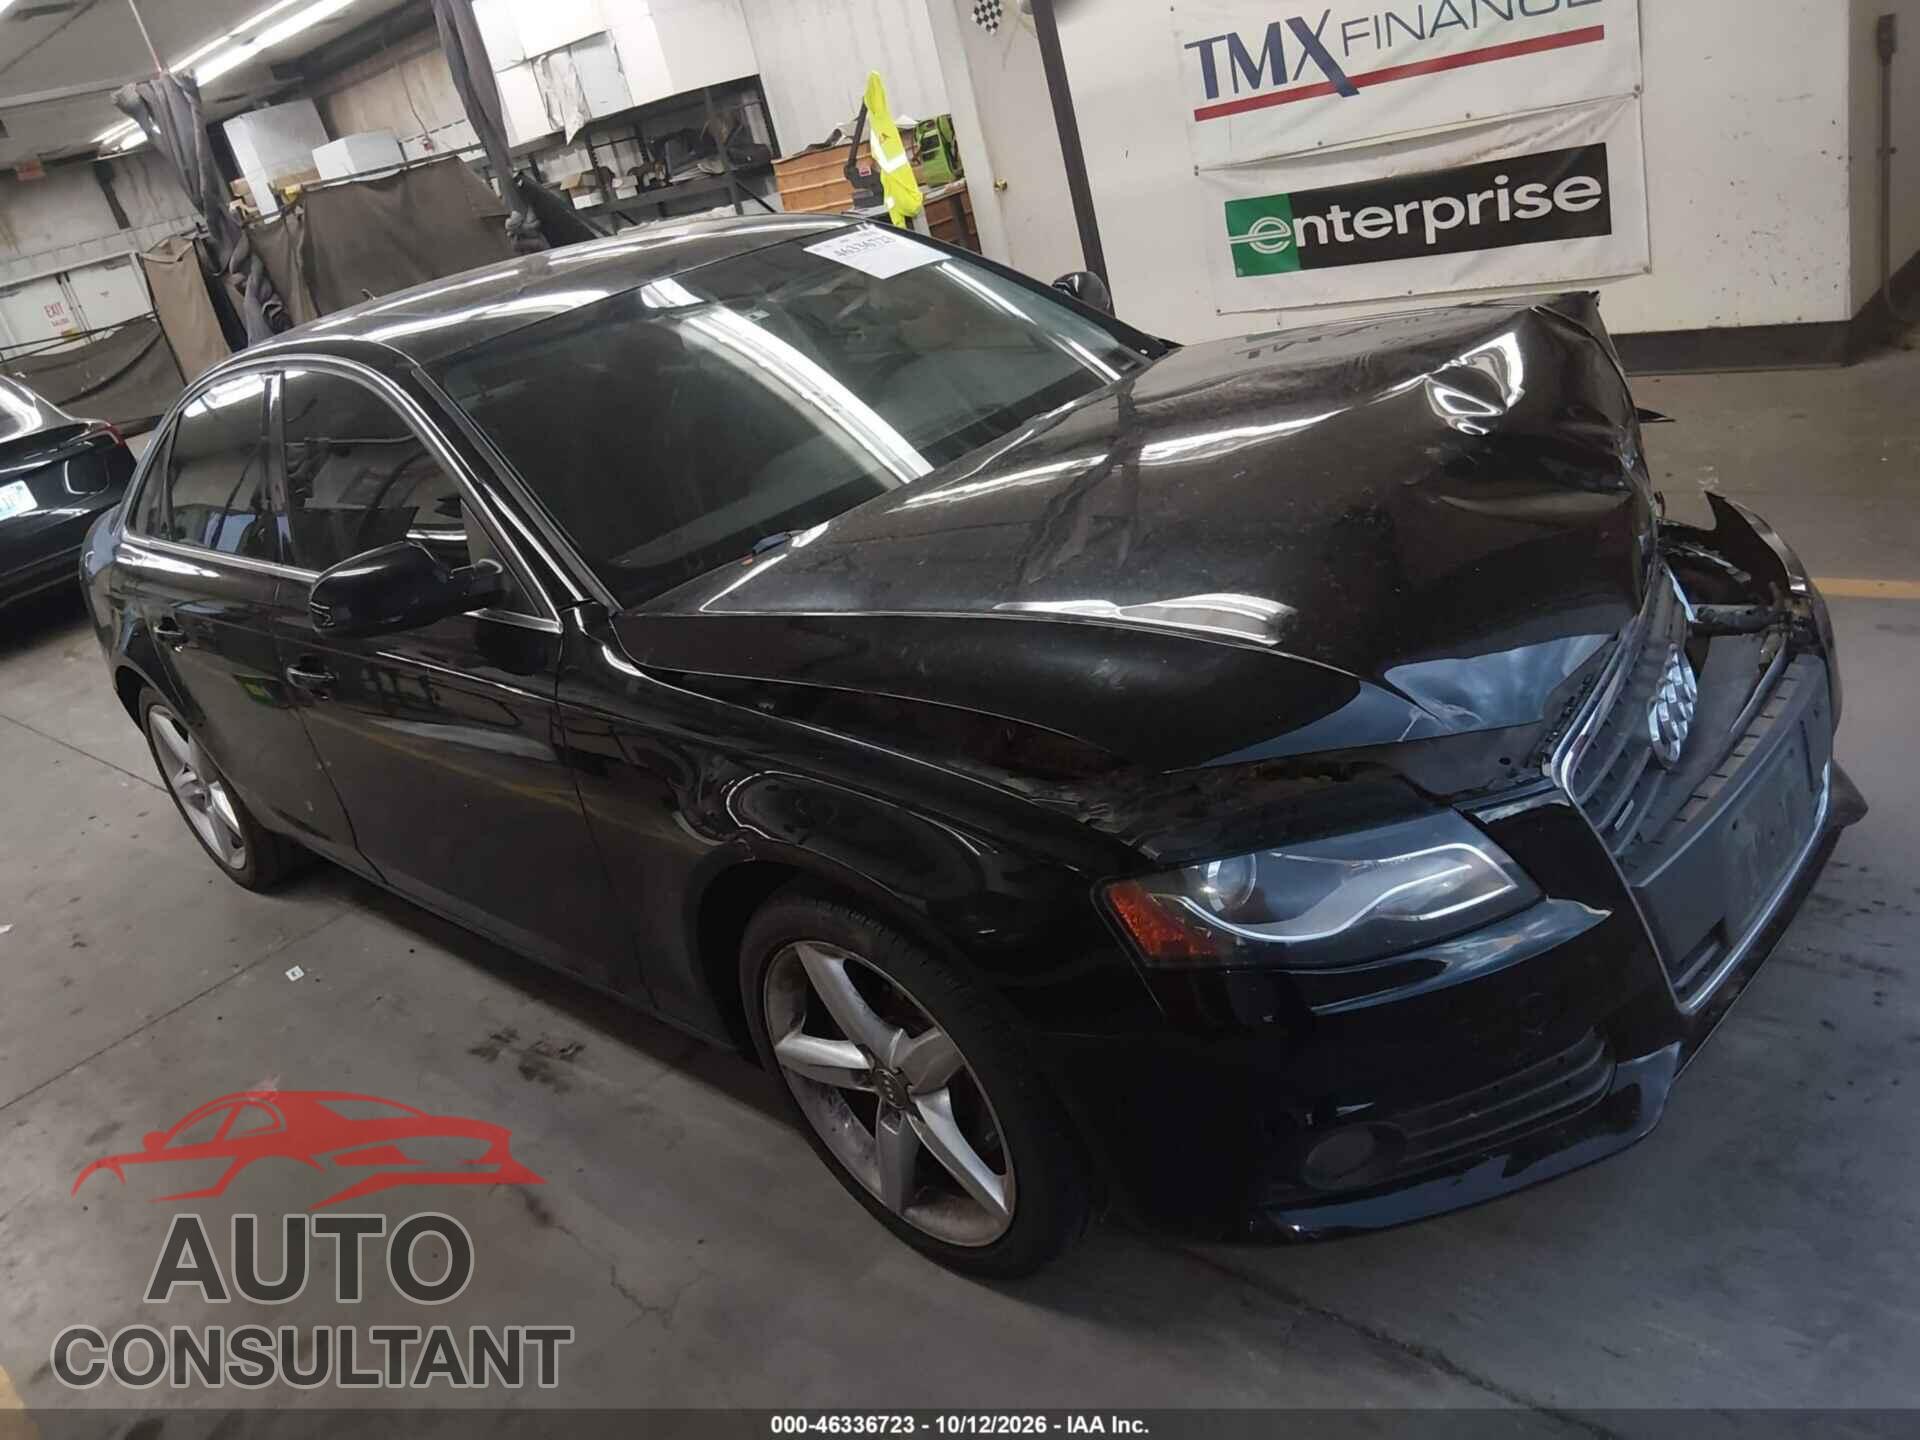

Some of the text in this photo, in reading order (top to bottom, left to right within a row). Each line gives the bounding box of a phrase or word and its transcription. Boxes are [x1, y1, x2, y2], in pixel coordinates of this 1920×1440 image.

[1184, 0, 1600, 99] TMX FINAN
[1229, 174, 1602, 254] enterprise
